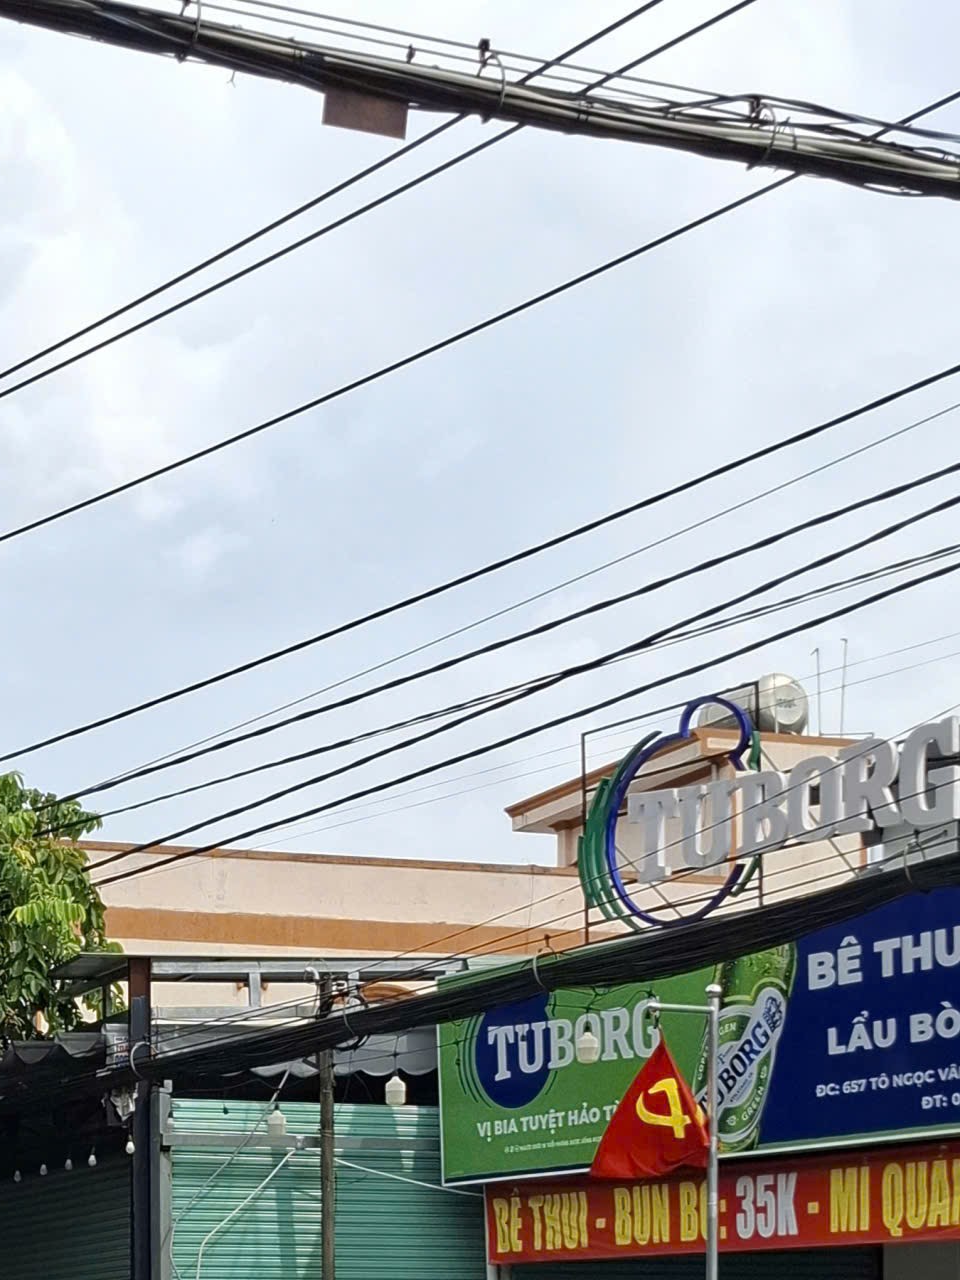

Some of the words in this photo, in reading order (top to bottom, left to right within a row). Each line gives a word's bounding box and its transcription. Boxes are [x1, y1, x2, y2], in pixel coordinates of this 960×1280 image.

[628, 715, 960, 884] TUBORG
[808, 936, 863, 991] BÊ
[488, 997, 661, 1082] TUBORG
[827, 1010, 896, 1056] LẨU
[909, 1001, 960, 1043] BÒ
[815, 1082, 840, 1097] ĐC:
[842, 1079, 867, 1094] 657
[869, 1073, 889, 1091] TÔ
[892, 1069, 935, 1088] NGỌC
[921, 1094, 948, 1109] ĐT:
[476, 1122, 493, 1142] VỊ
[494, 1118, 518, 1136] BIA
[520, 1109, 565, 1135] TUYỆT
[568, 1102, 601, 1126] HẢO
[493, 1187, 523, 1253] BÊ
[528, 1191, 588, 1250] THUI
[736, 1172, 799, 1239] 35K
